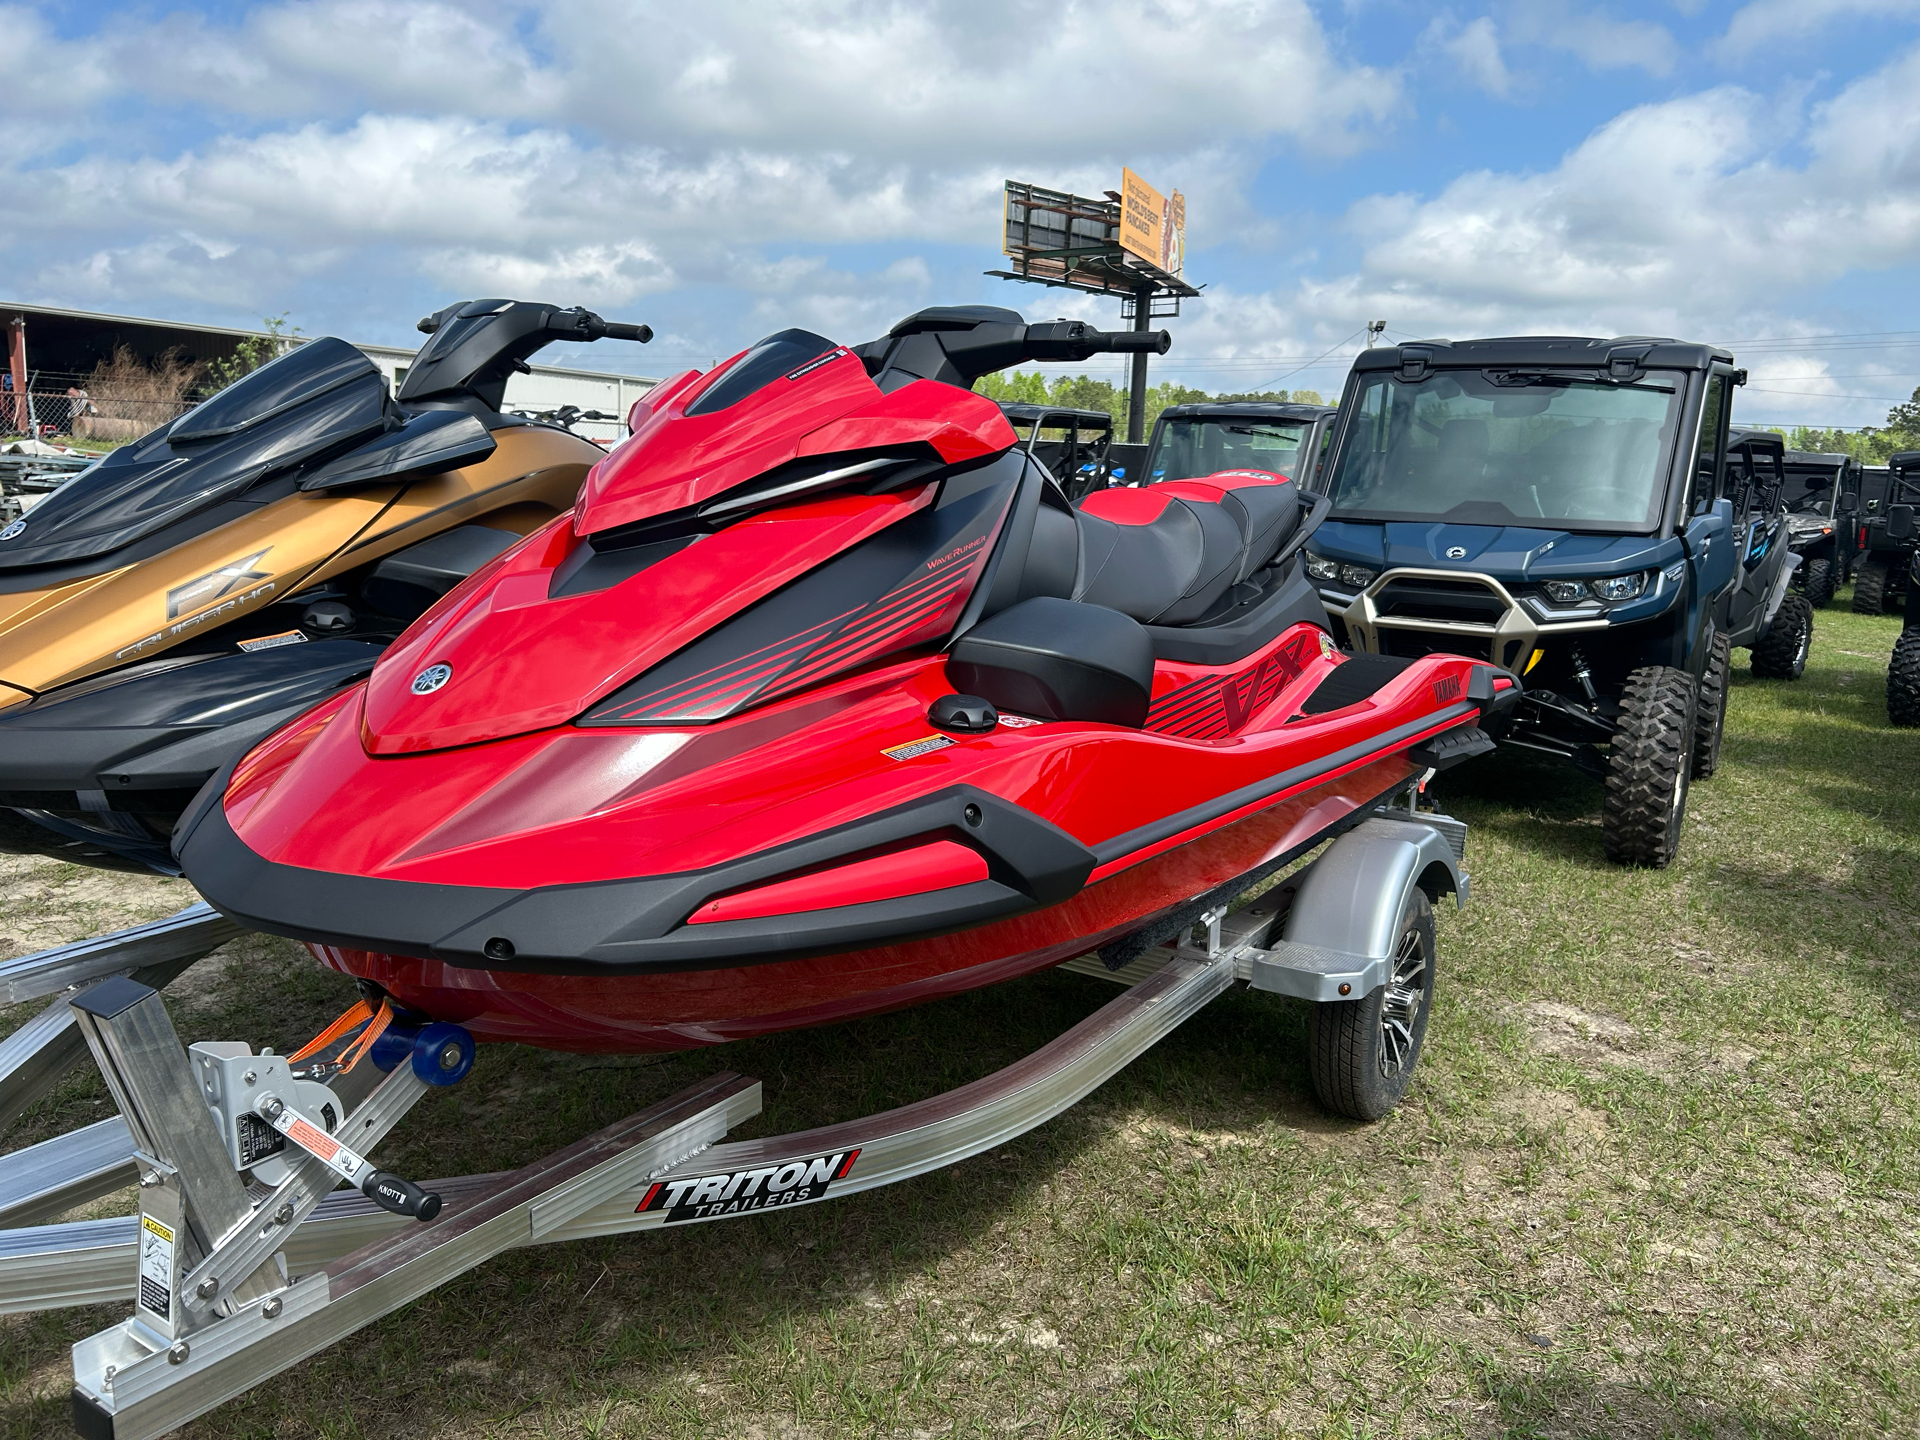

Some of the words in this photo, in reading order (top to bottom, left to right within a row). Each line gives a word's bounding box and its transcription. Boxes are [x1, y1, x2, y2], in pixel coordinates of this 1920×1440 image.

[1126, 210, 1150, 236] PANCAKES
[1539, 541, 1554, 555] HD10
[167, 545, 275, 622] FX
[115, 600, 236, 661] CRUISER
[1220, 634, 1307, 735] VX
[1432, 674, 1461, 706] YAMAHA
[378, 1184, 401, 1200] KNOTT
[662, 1153, 844, 1209] TRITON
[694, 1187, 811, 1218] TRAILERS
[150, 1222, 171, 1240] CAUTION
